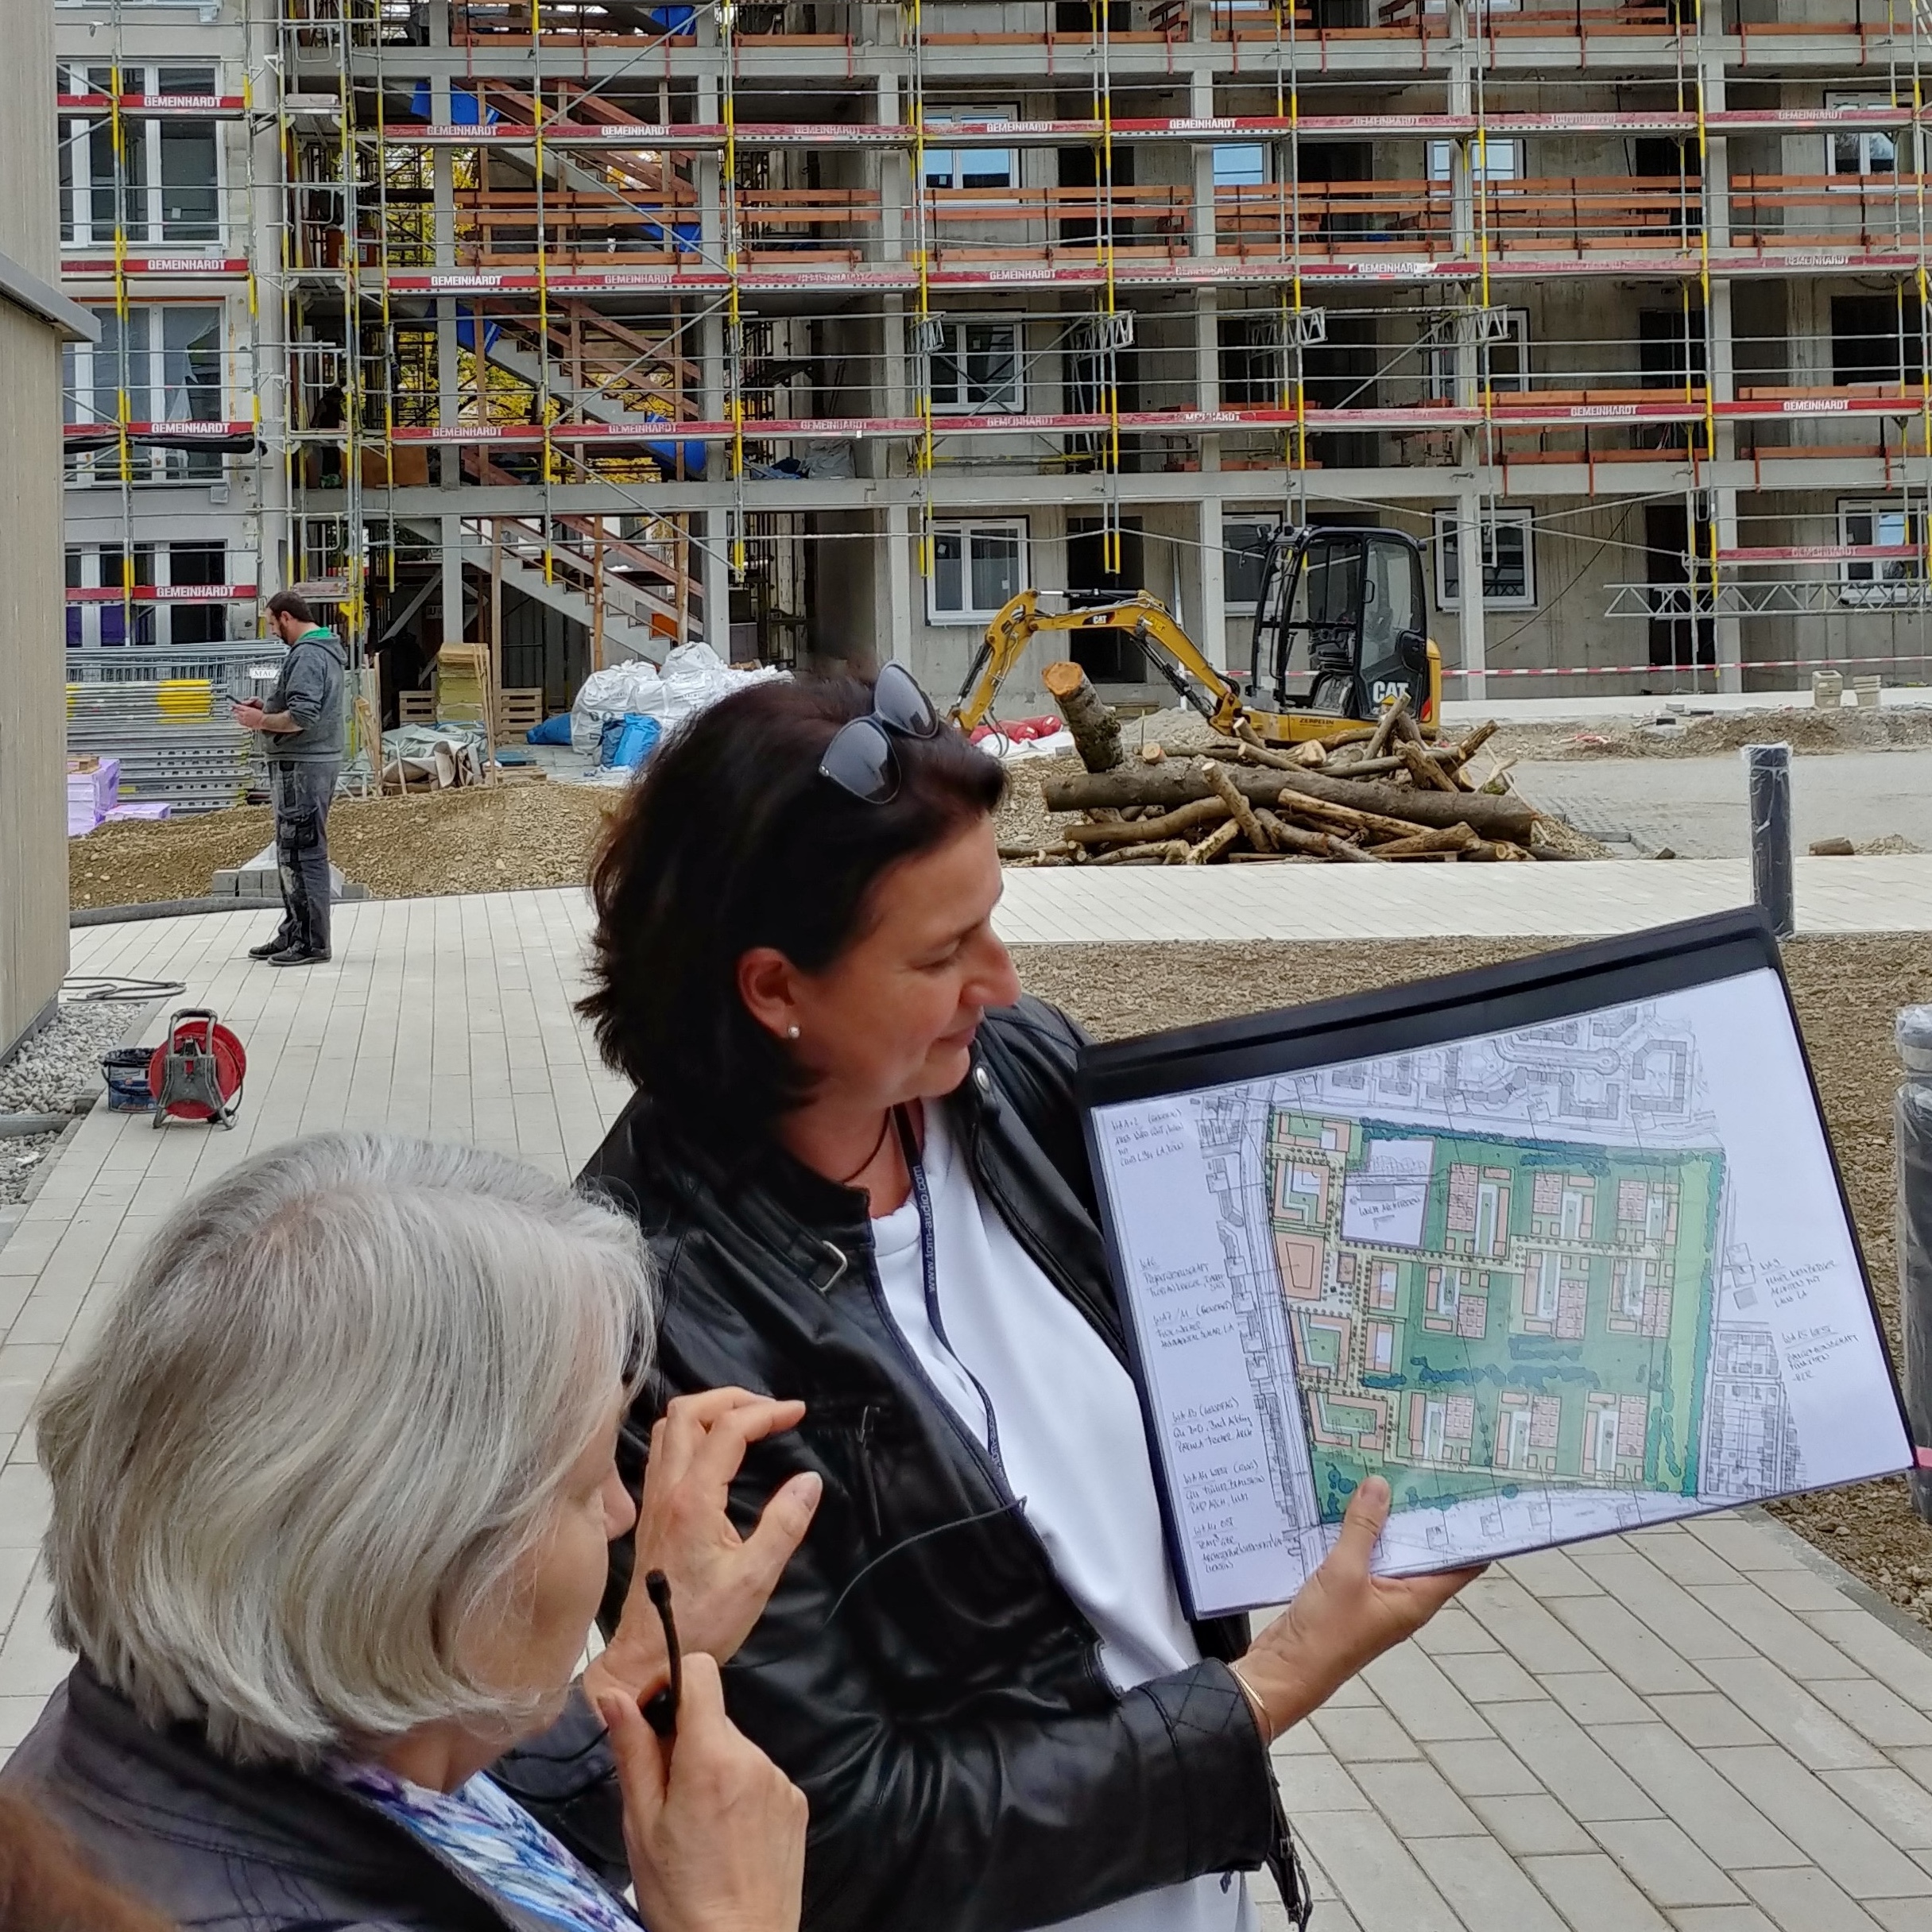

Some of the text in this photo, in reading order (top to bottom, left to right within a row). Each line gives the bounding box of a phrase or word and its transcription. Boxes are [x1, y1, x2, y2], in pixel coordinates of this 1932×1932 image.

[144, 95, 221, 107] GEMEINHARDT
[1779, 110, 1842, 119] GEMEINHARDT
[987, 122, 1051, 133] GEMEINHARDT
[1170, 118, 1237, 129] GEMEINHARDT
[427, 125, 497, 137] GEMEINHARDT
[602, 125, 670, 136] GEMEINHARDT
[149, 259, 225, 270] GEMEINHARDT
[432, 274, 501, 286] GEMEINHARDT
[605, 274, 672, 285] GEMEINHARDT
[990, 269, 1055, 281] GEMEINHARDT
[1571, 405, 1637, 416] GEMEINHARDT
[1784, 400, 1849, 410] GEMEINHARDT
[152, 422, 230, 434] GEMEINHARDT
[433, 427, 501, 437] GEMEINHARDT
[609, 424, 676, 434] GEMEINHARDT
[157, 586, 234, 598] GEMEINHARDT
[1093, 615, 1107, 625] CAT
[1373, 681, 1409, 704] CAT
